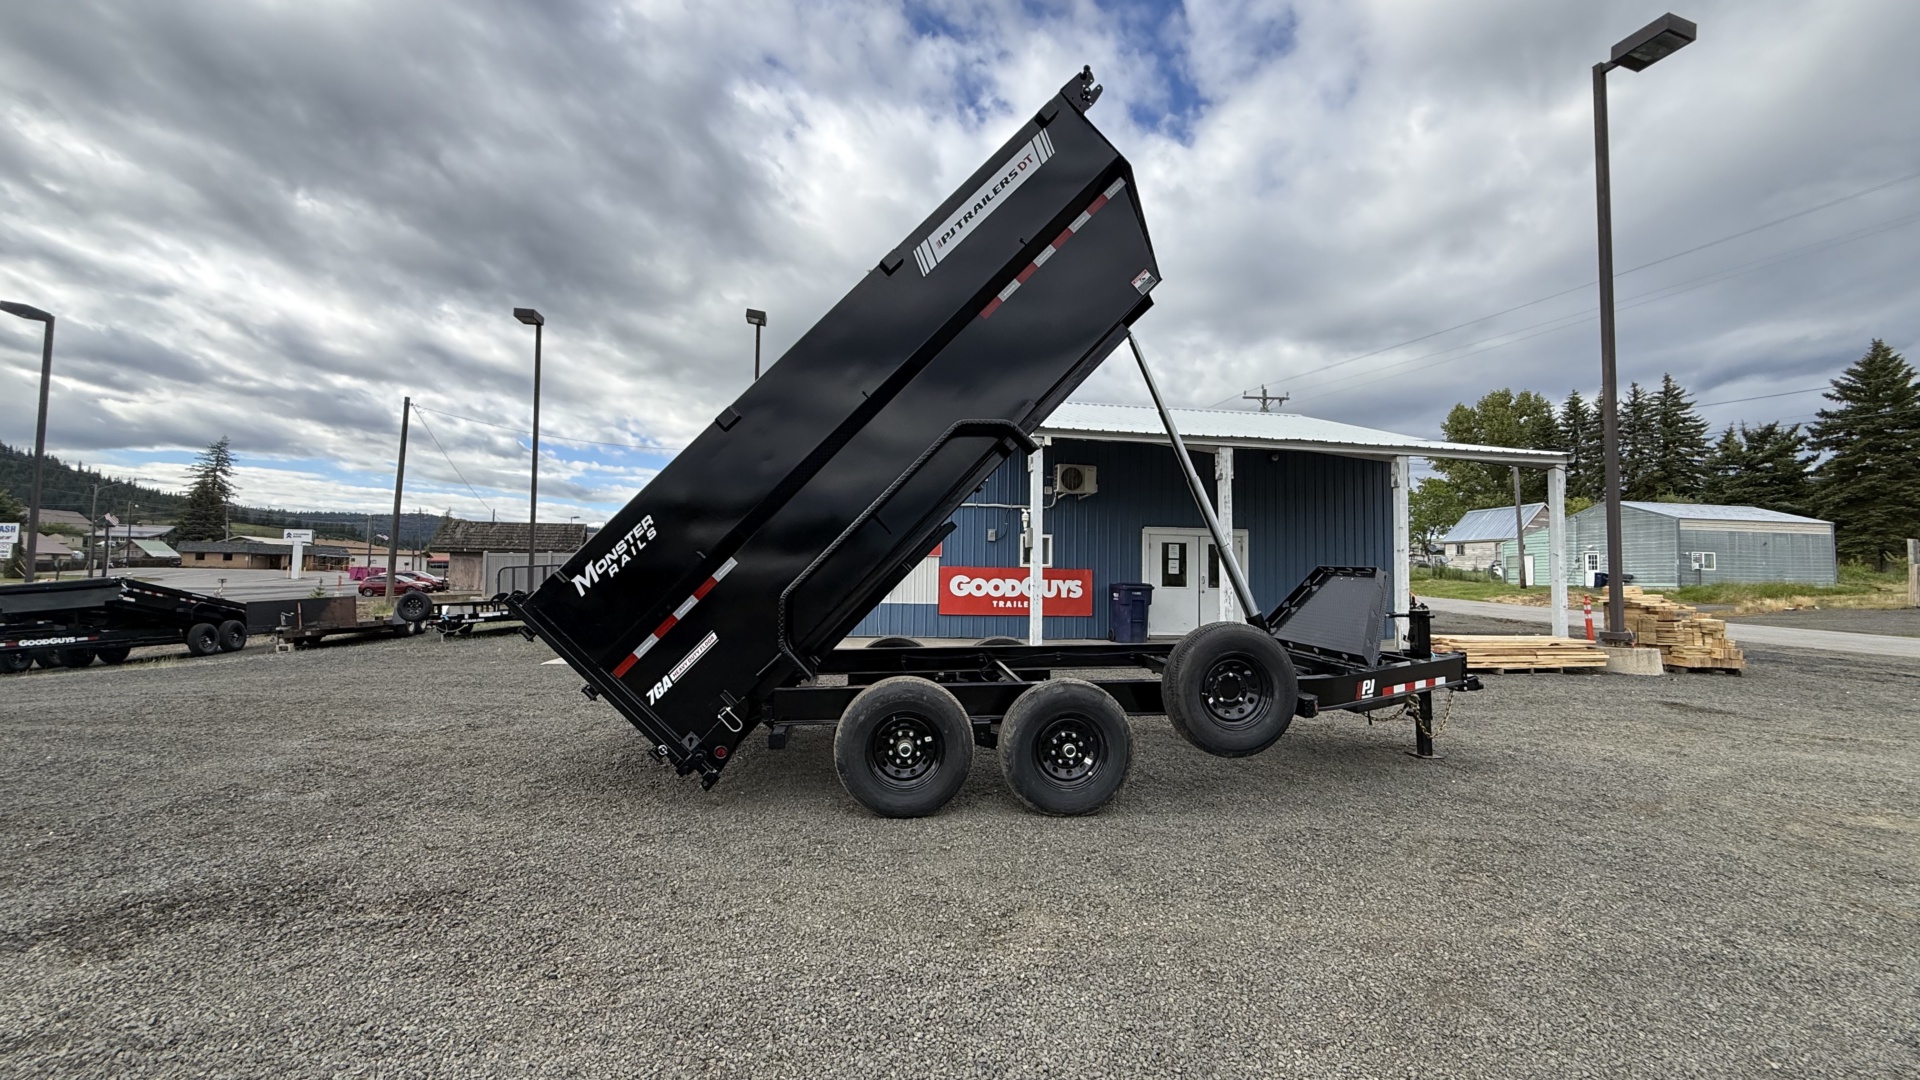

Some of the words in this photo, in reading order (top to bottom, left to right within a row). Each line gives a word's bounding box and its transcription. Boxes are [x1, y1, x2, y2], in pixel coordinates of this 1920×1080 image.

[941, 227, 956, 244] PJ
[955, 169, 1018, 229] TRAILERS
[1017, 154, 1033, 171] DT
[571, 514, 654, 597] MONSTER
[607, 526, 657, 578] RAILS
[992, 600, 1029, 608] TRAILE
[18, 636, 76, 647] GOODGUYS
[645, 674, 674, 706] 7GA
[672, 661, 688, 678] HEAVY
[687, 650, 701, 664] DUTY
[699, 635, 715, 652] FLOOR
[1361, 679, 1375, 695] PJ
